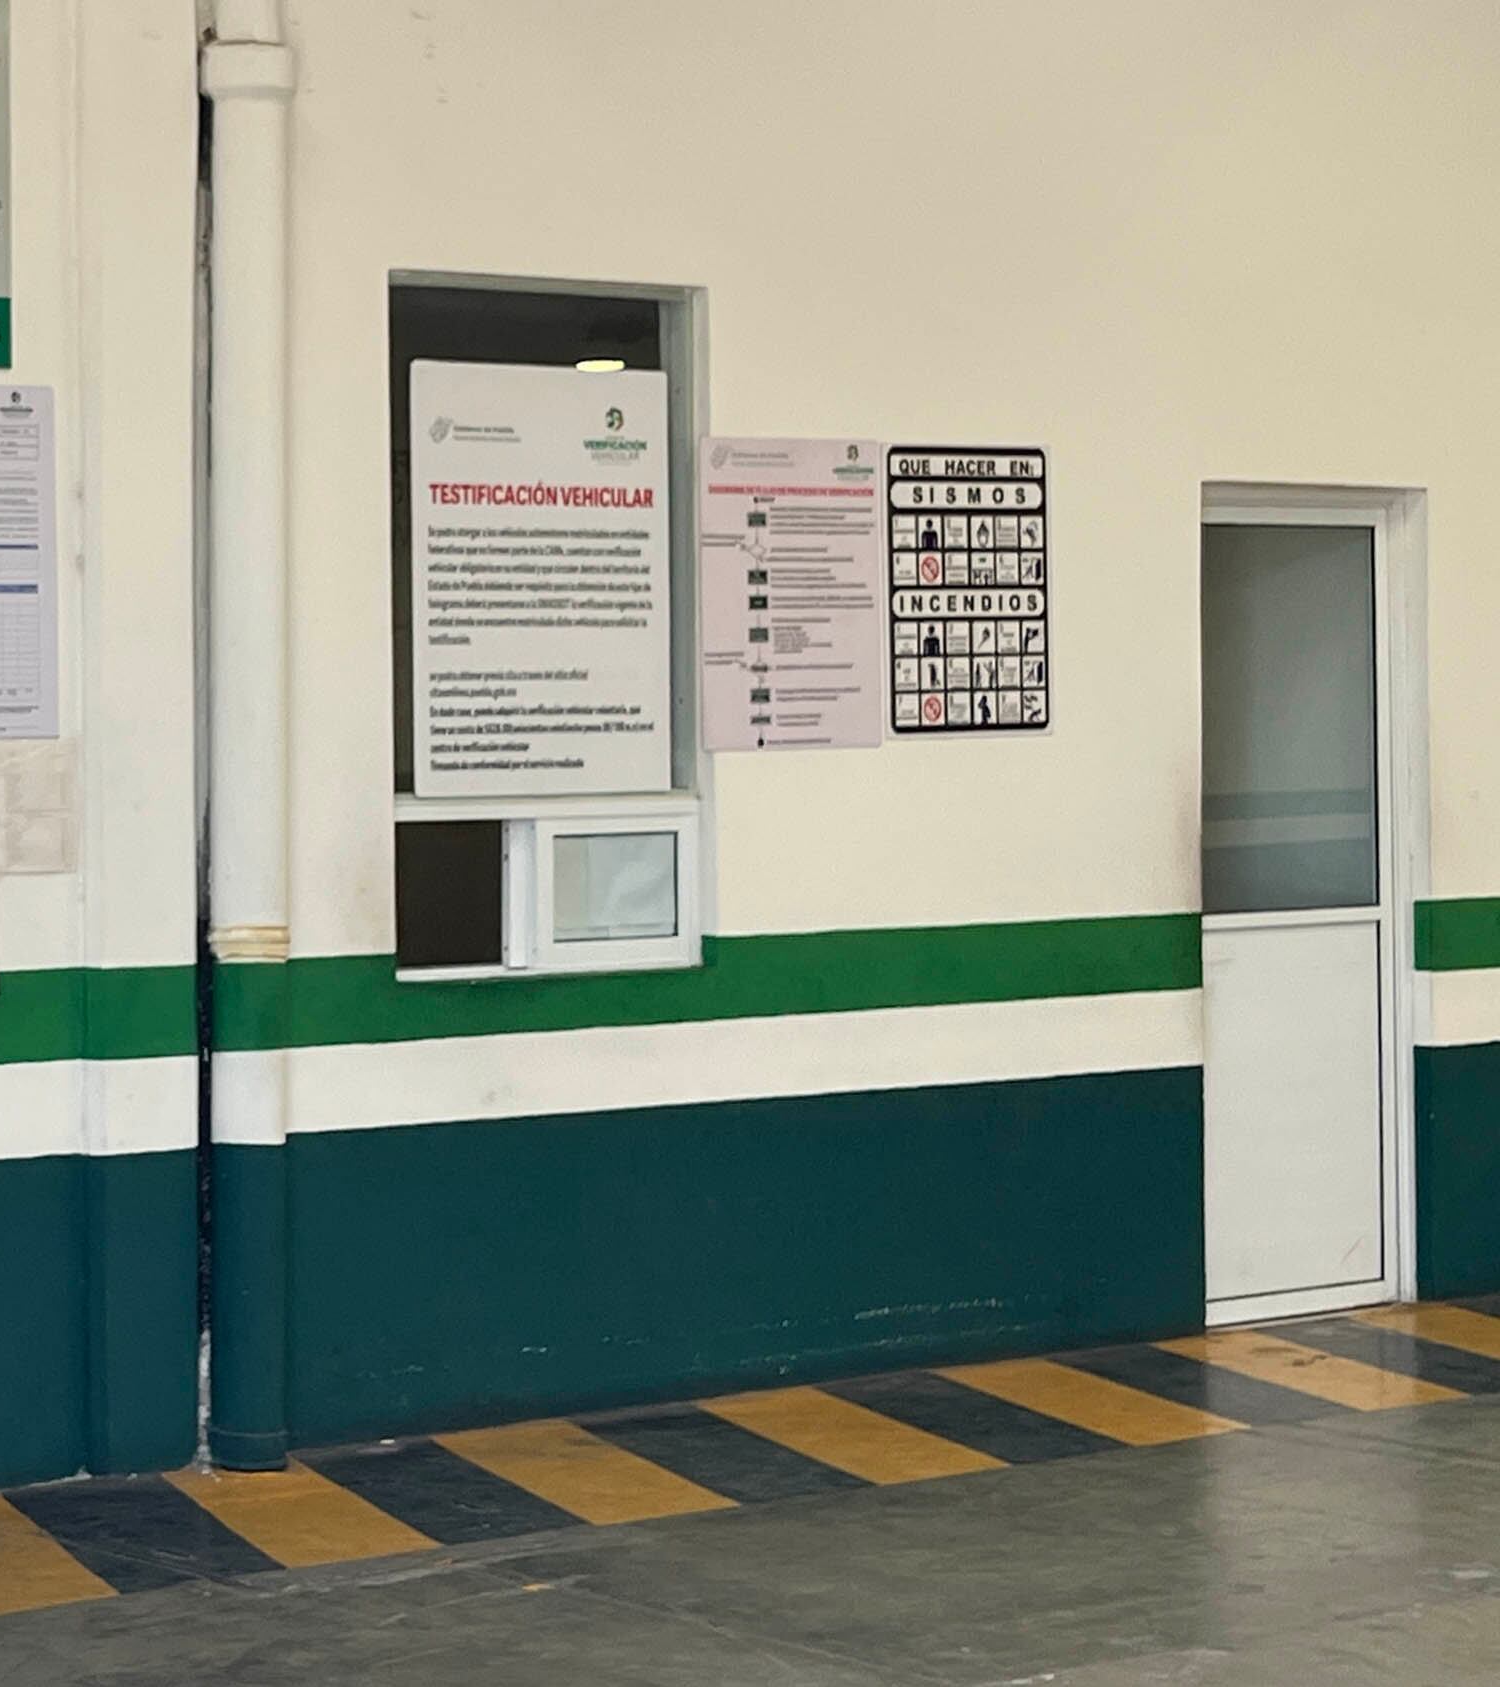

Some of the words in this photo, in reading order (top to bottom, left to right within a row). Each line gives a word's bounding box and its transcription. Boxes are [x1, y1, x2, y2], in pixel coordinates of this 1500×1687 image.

[899, 459, 931, 476] QUE
[945, 459, 996, 476] HACER
[429, 480, 558, 506] TESTIFICACIÓN
[560, 486, 654, 508] VEHICULAR
[913, 486, 1027, 505] SISMOS
[899, 594, 1038, 613] INCENDIOS
